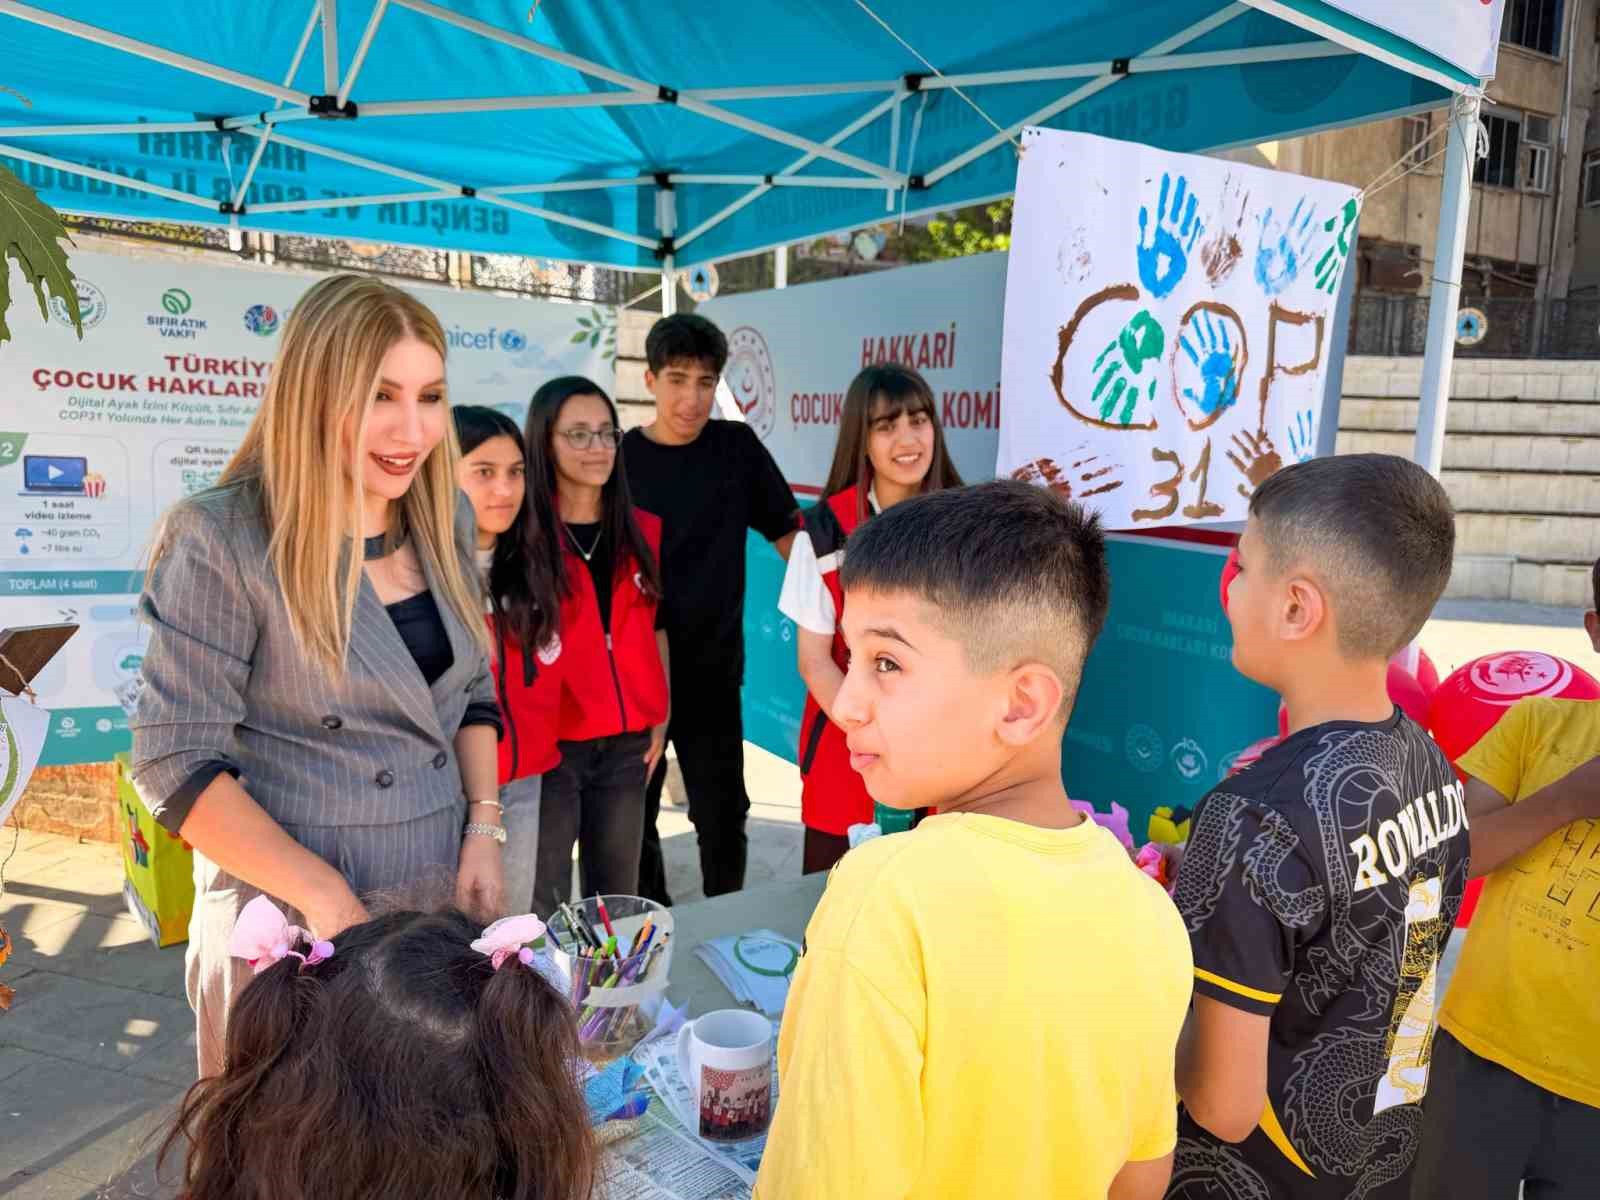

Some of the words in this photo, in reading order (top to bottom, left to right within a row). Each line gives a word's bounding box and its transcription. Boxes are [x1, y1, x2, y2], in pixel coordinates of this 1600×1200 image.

[147, 315, 178, 327] SIFIR
[180, 318, 207, 329] ATIK
[159, 327, 196, 340] VAKFI
[861, 321, 956, 369] HAKKARİ
[1051, 282, 1326, 436] COP
[33, 368, 137, 392] ÇOCUK
[67, 396, 104, 409] Dijital
[108, 398, 139, 410] Ayak
[58, 409, 102, 422] COP31
[107, 412, 157, 425] Yolunda
[160, 415, 182, 426] Her
[3, 441, 14, 457] 2
[1131, 437, 1226, 522] 31
[24, 510, 55, 521] video
[57, 511, 92, 521] izleme
[8, 579, 58, 590] TOPLAM
